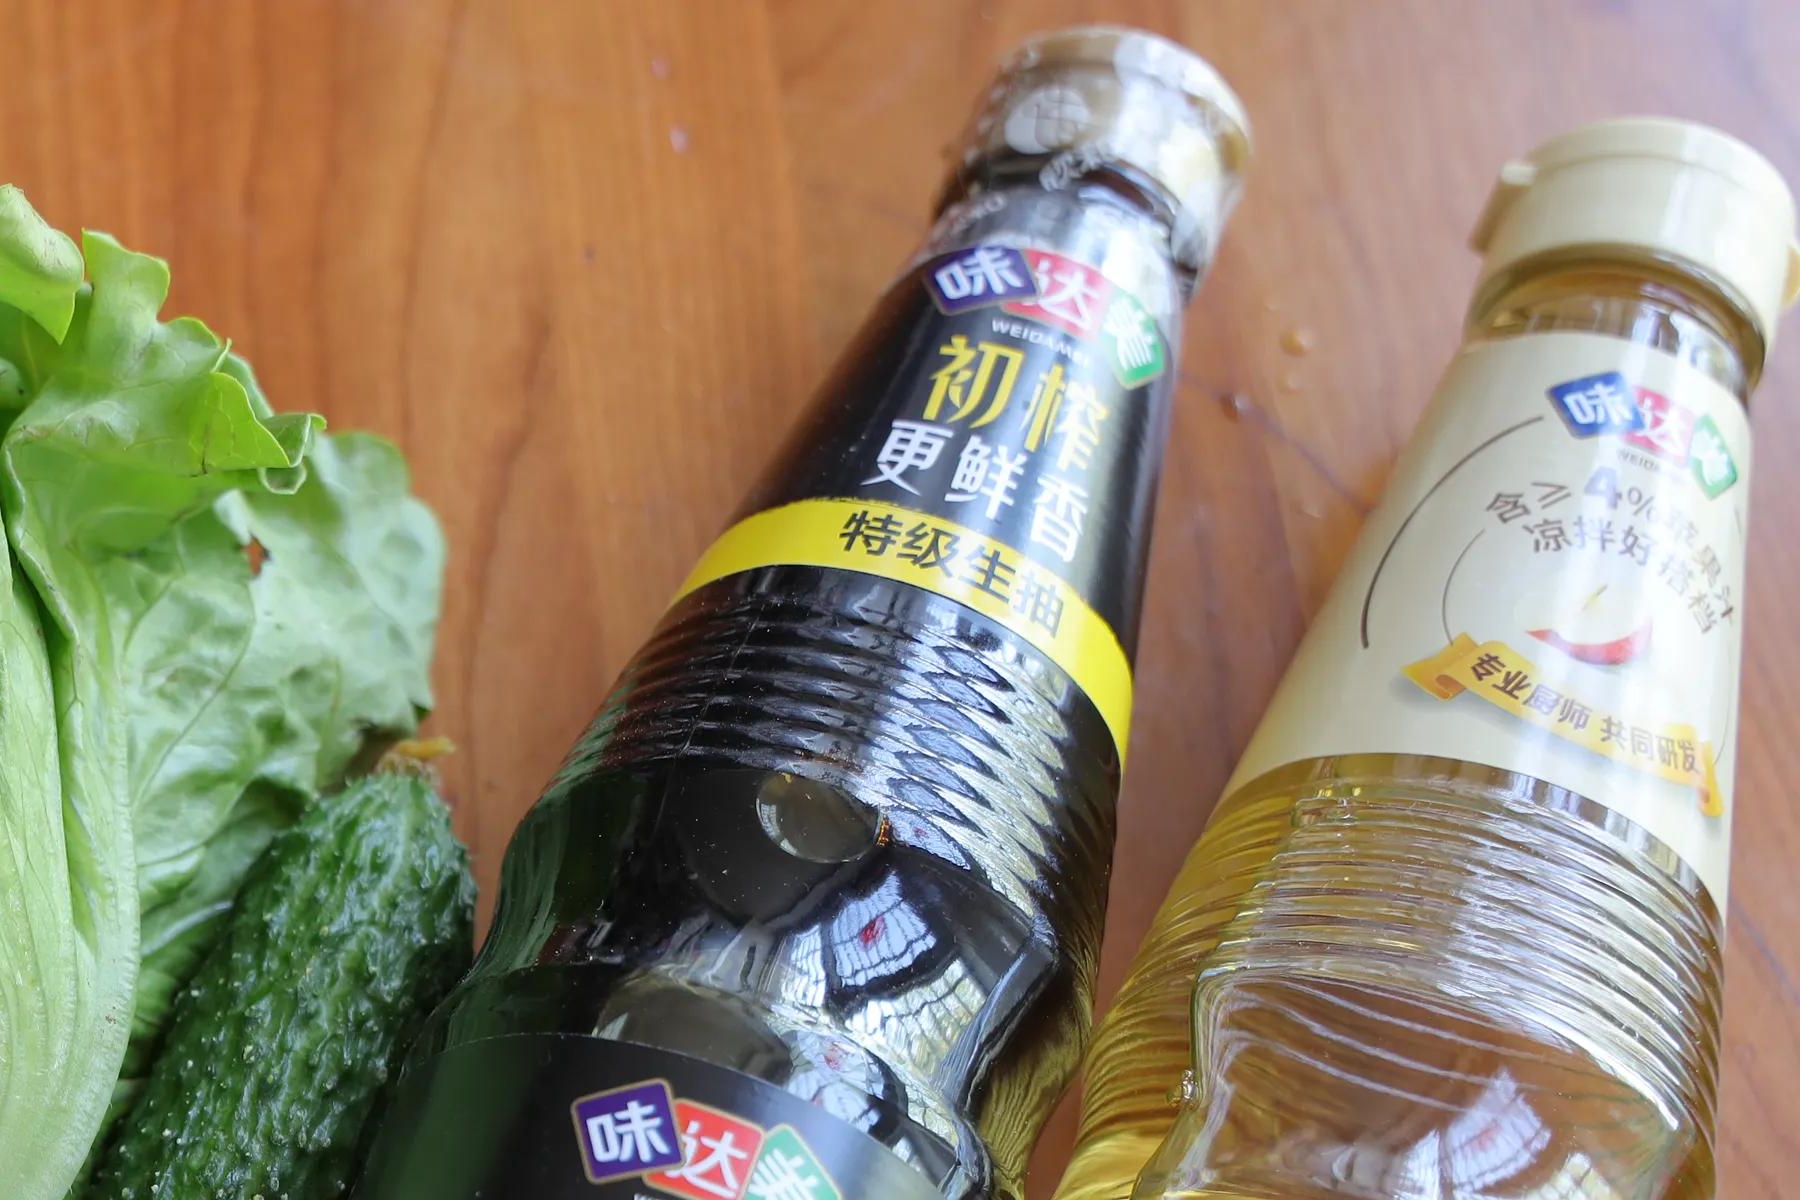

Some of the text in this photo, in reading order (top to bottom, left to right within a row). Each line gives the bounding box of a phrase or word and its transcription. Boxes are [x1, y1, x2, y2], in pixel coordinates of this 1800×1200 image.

[935, 246, 1154, 370] 味达美
[922, 335, 1109, 471] 初榨
[861, 419, 1089, 564] 更鲜香
[839, 510, 1065, 639] 特级生抽
[1470, 652, 1700, 775] 专业厨师 共同研发
